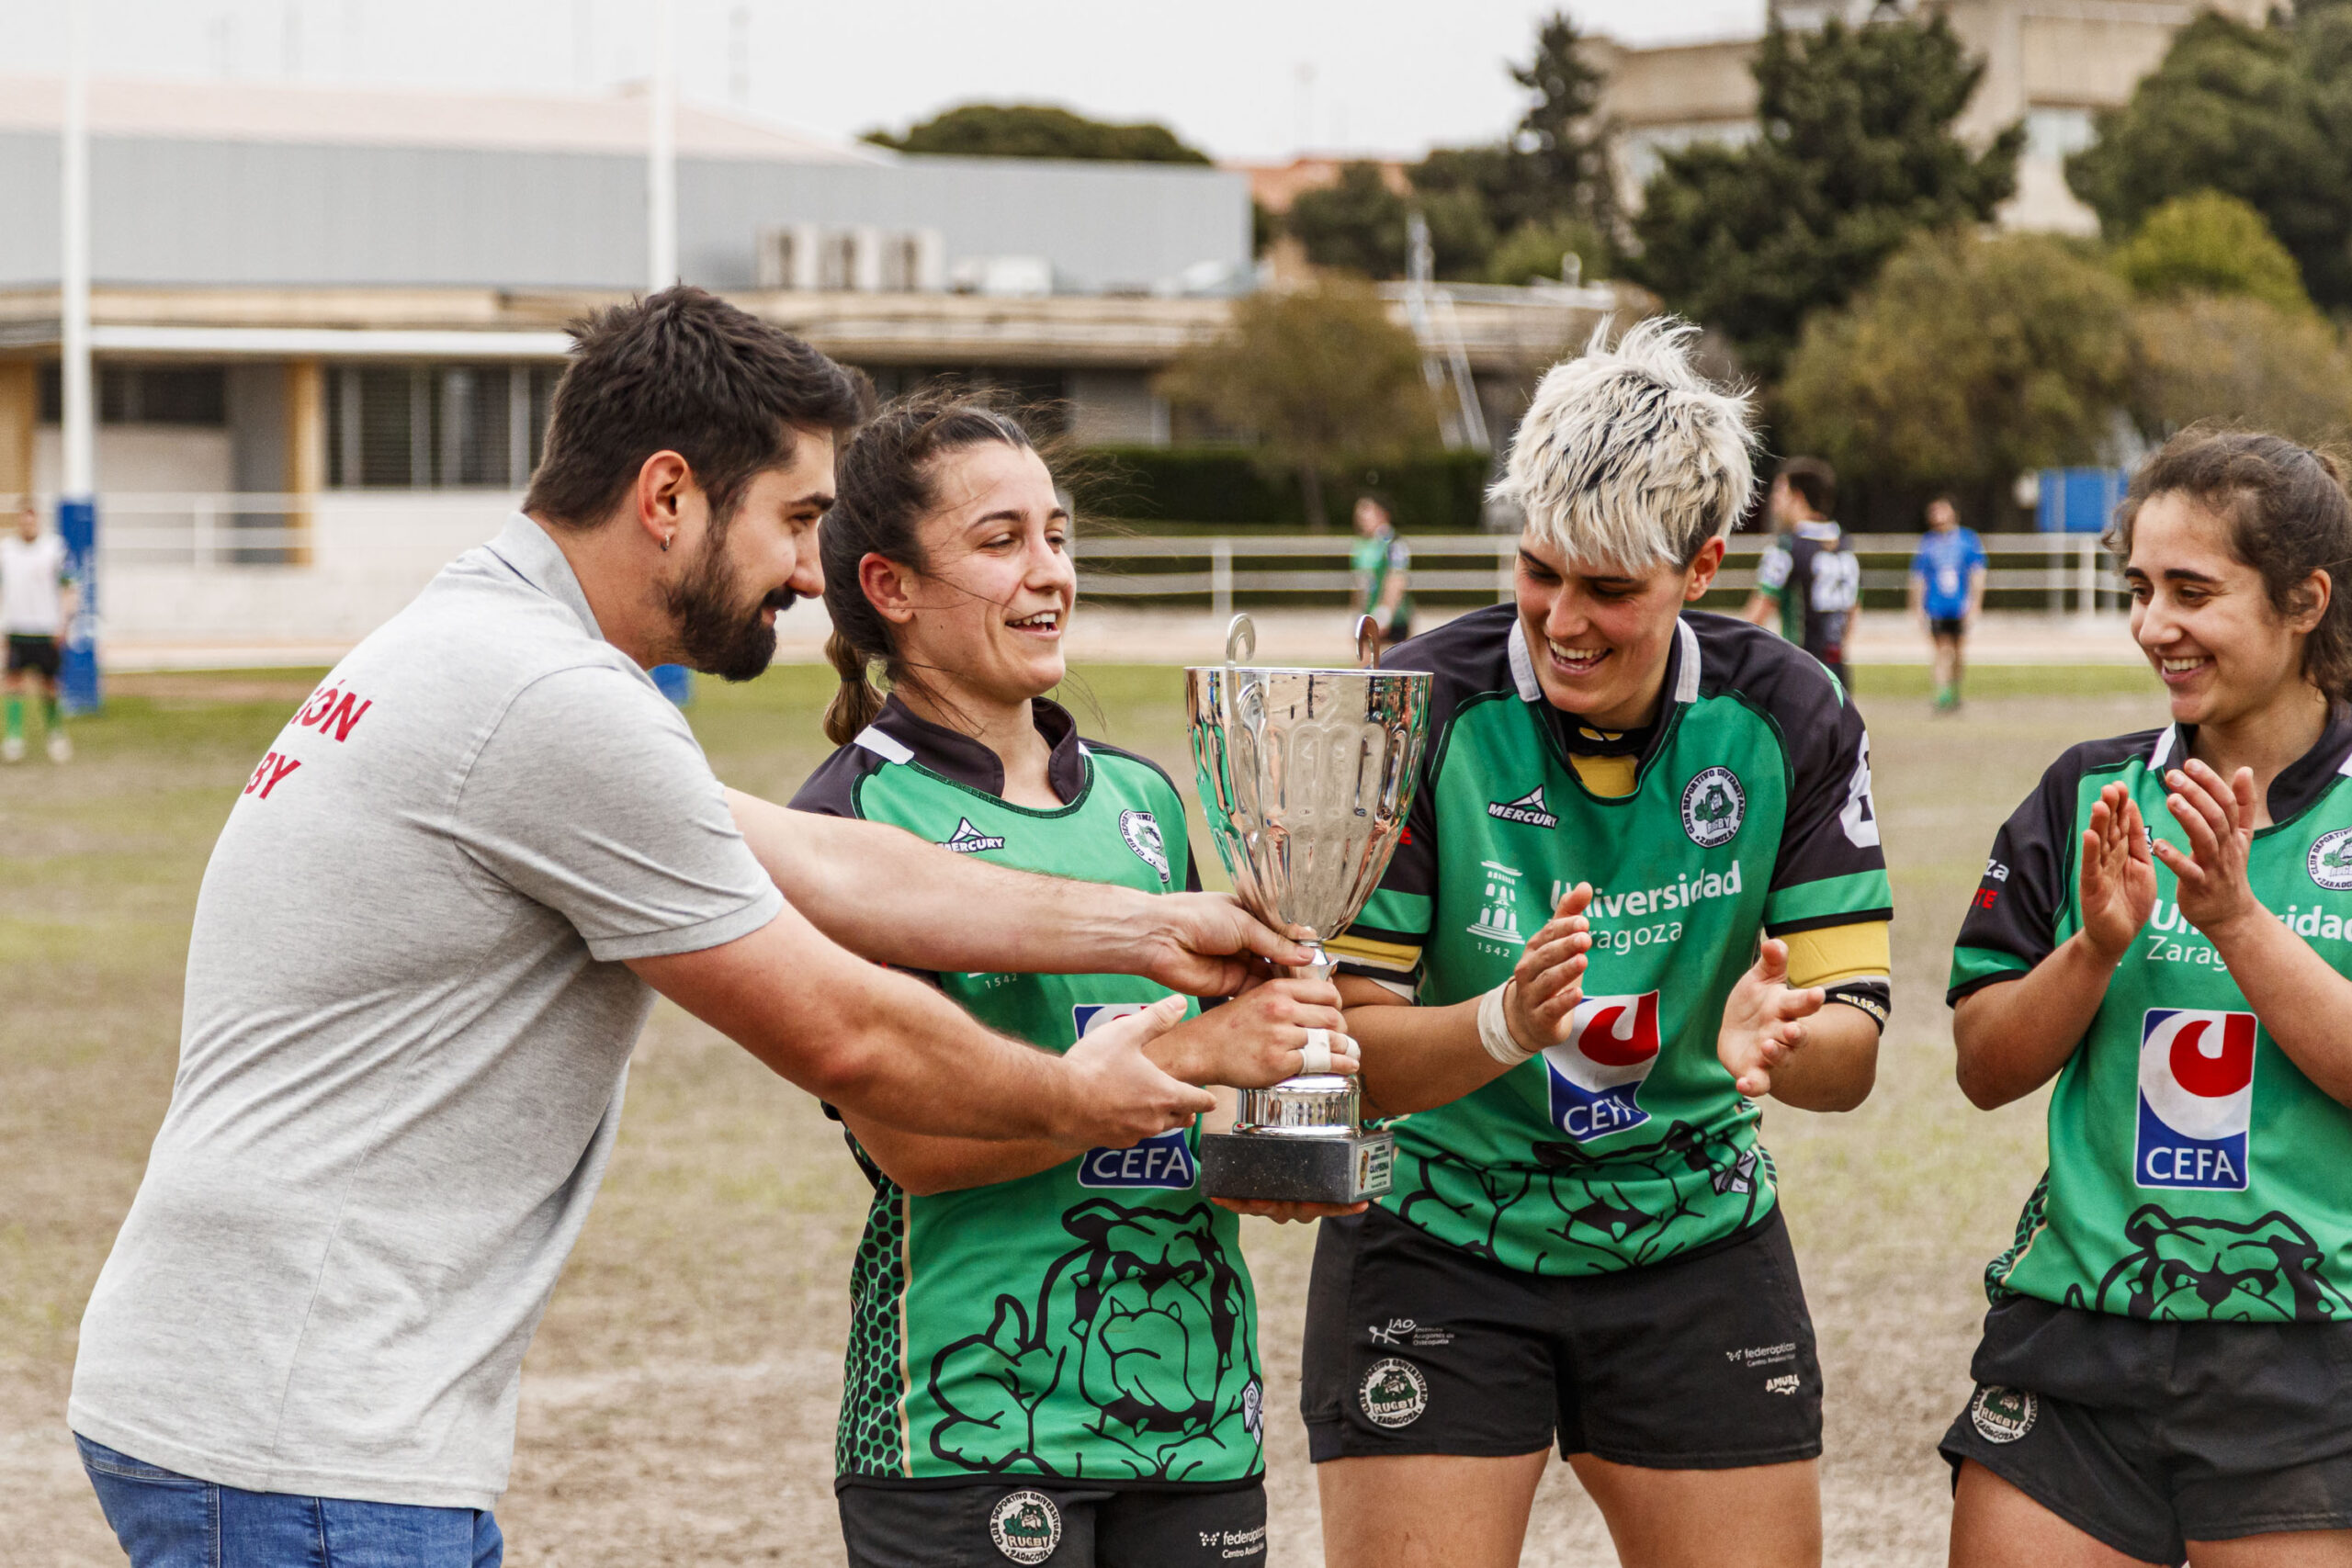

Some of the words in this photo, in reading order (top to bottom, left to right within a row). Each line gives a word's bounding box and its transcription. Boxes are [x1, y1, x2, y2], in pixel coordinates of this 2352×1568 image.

[1488, 803, 1557, 828] MERCURY
[1550, 860, 1742, 918] Uiversidad
[1477, 942, 1510, 958] 1542
[1092, 1146, 1190, 1180] CEFA
[2146, 1146, 2239, 1182] CEFA
[1374, 1397, 1415, 1415] RUGBY
[1980, 1407, 2019, 1431] RUGBY
[1007, 1535, 1050, 1549] RUGBY
[1010, 1549, 1050, 1562] ZARAGOZA
